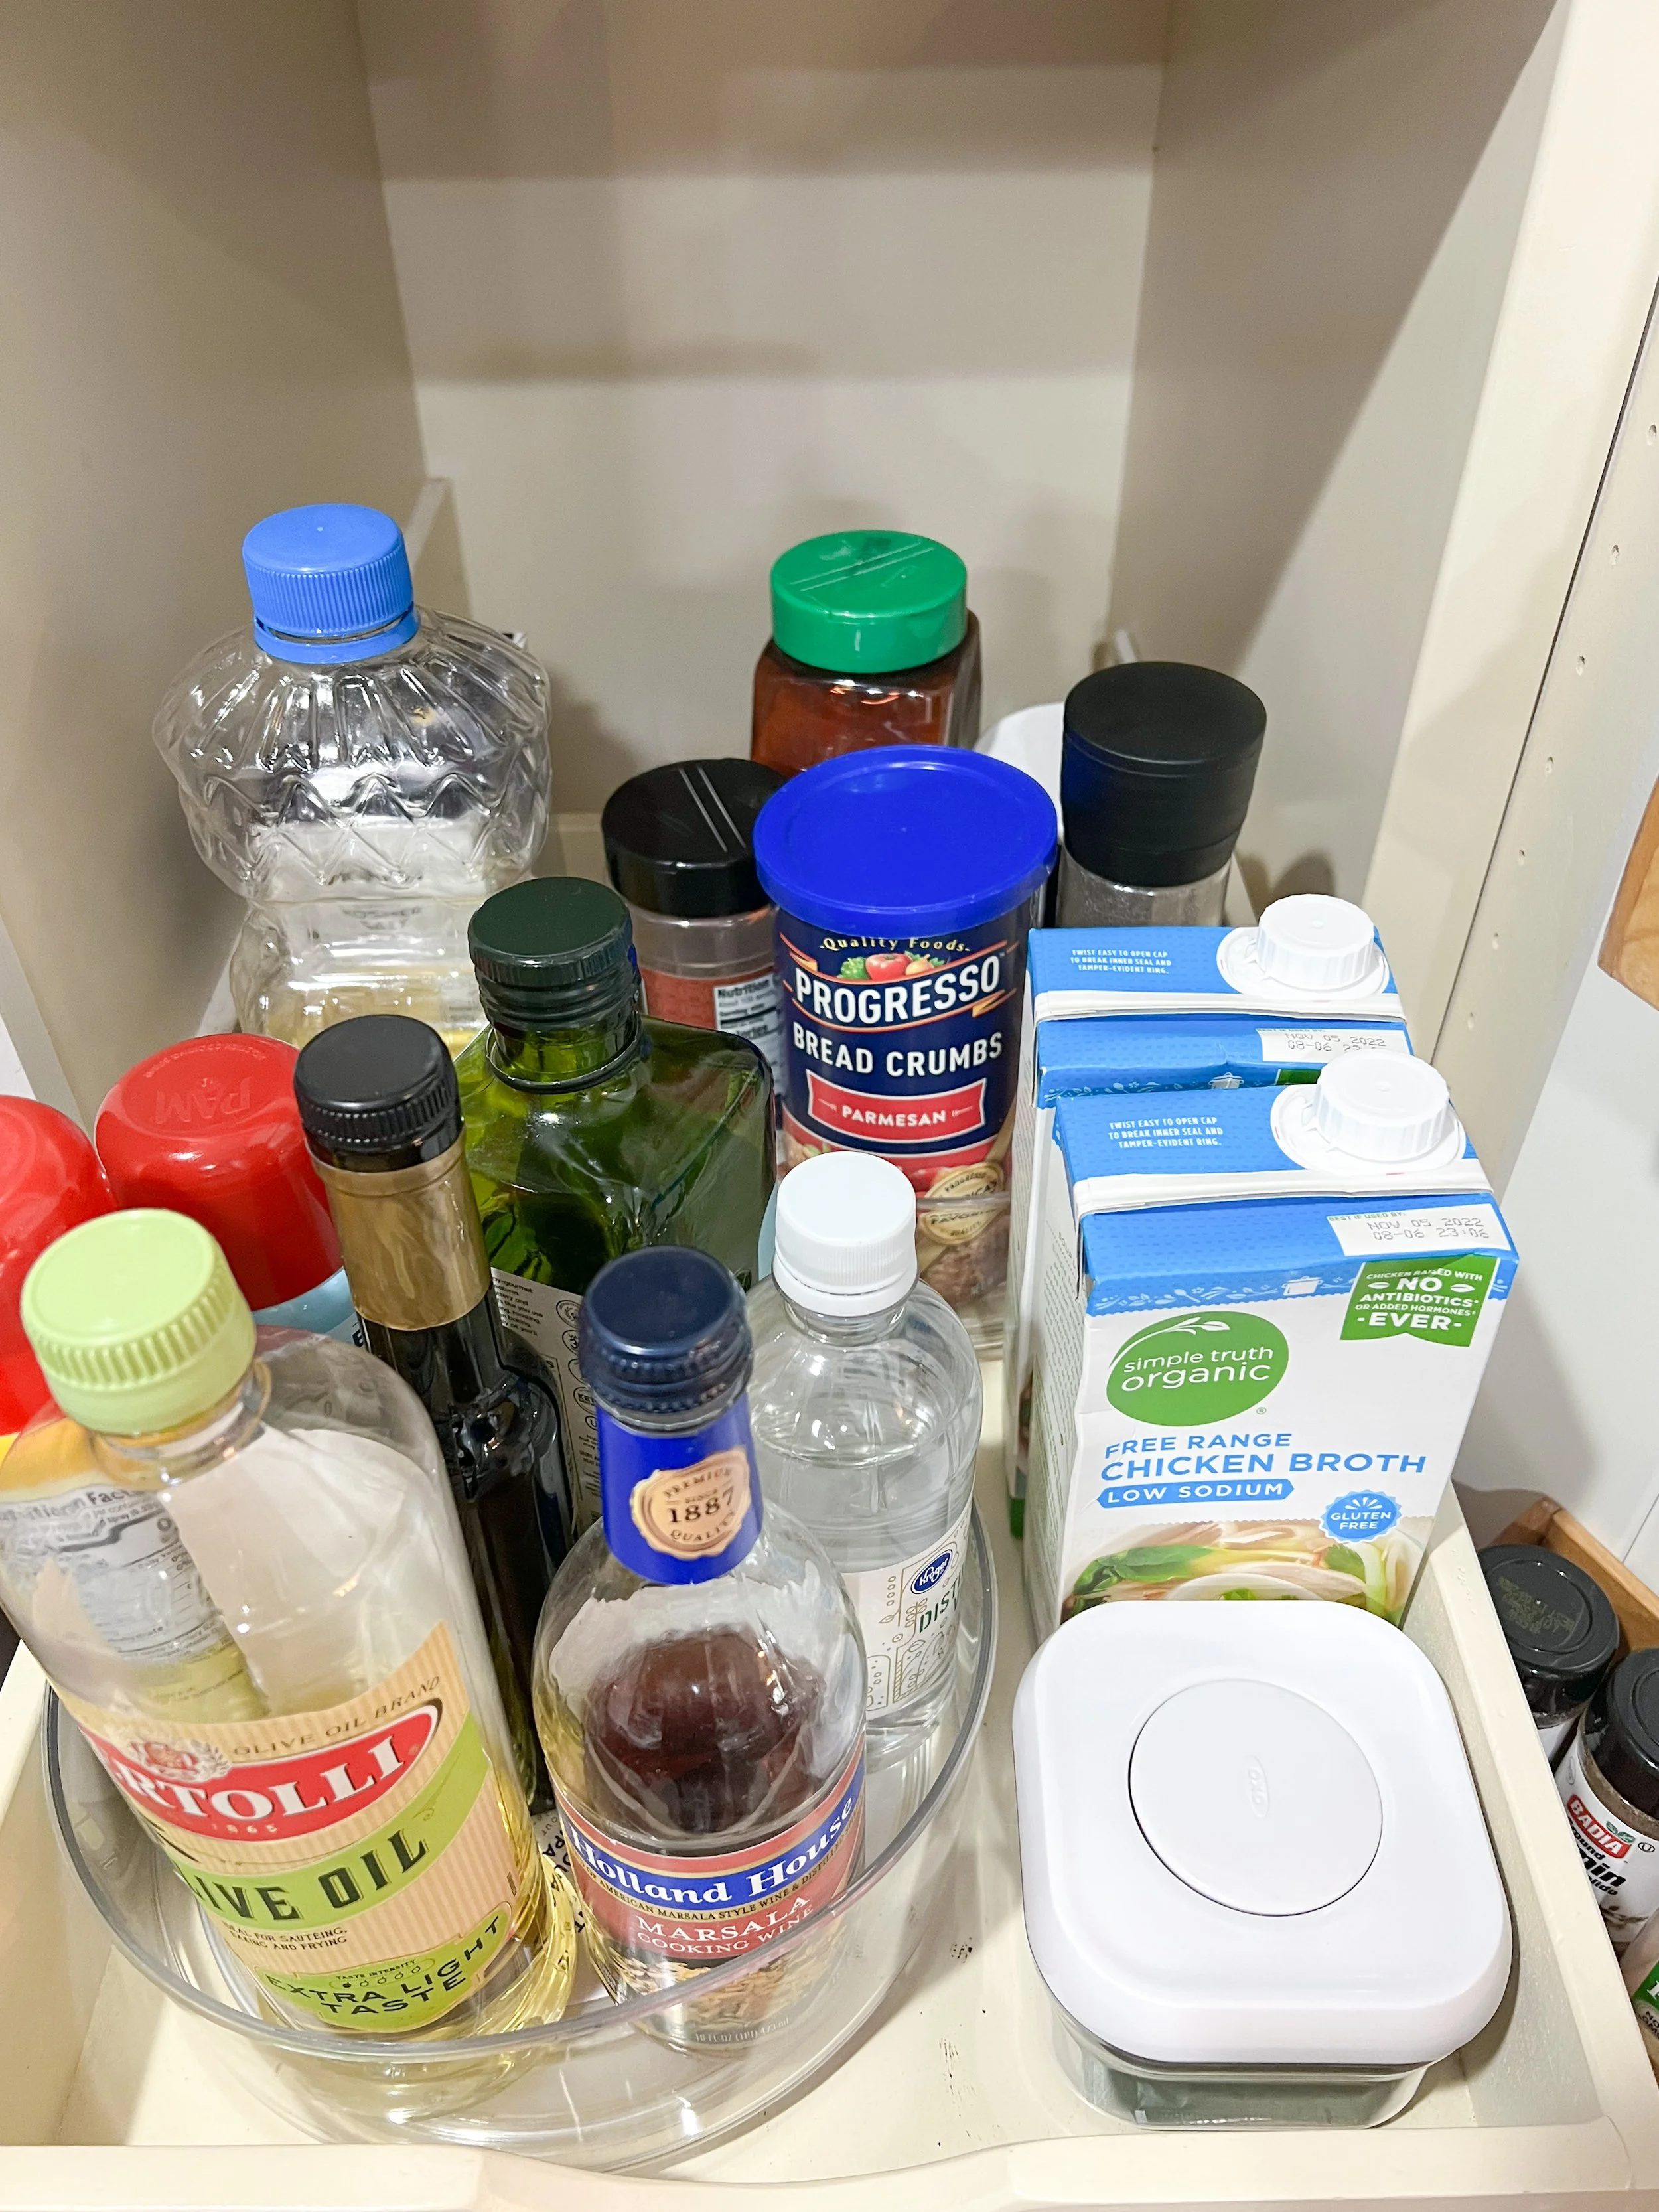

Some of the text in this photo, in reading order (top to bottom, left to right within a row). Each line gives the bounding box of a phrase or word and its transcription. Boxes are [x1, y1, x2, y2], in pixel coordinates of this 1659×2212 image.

[822, 936, 966, 952] Quality Foods
[1078, 964, 1145, 973] TAMPER-EVIDENT
[796, 955, 1000, 1025] PROGRESSO
[792, 1021, 1003, 1077] BREAD CRUMBS
[1287, 1040, 1332, 1051] 08-06
[1350, 1036, 1386, 1047] 2022
[841, 1104, 946, 1127] PARMESAN
[1109, 1116, 1217, 1130] TWIST EASY TO OPEN CAP
[1118, 1138, 1222, 1149] TAMPER-EVIDENT RING.
[1121, 1130, 1151, 1138] BREAK
[1153, 1128, 1180, 1137] INNER
[1183, 1128, 1202, 1136] SEAL
[1205, 1127, 1224, 1136] AND
[1366, 1218, 1485, 1230] NOV 05 2022
[1373, 1227, 1490, 1240] 08-06 23:06
[1366, 1270, 1412, 1280] CHICKEN
[1455, 1270, 1483, 1282] WITH
[1396, 1277, 1443, 1291] NO
[1123, 1347, 1273, 1372] simple truth
[1121, 1361, 1271, 1392] organic
[1105, 1433, 1292, 1459] FREE RANGE
[1101, 1453, 1427, 1481] CHICKEN BROTH
[668, 1485, 735, 1523] 1887
[1107, 1483, 1283, 1503] LOW SODIUM
[670, 1510, 736, 1541] QUALITY
[1331, 1512, 1392, 1520] GLUTEN
[1339, 1521, 1378, 1530] FREE
[919, 1557, 949, 1587] Kroger
[234, 1676, 440, 1755] OLIVE OIL BRAND
[112, 1735, 405, 1820] RTOLLI
[1570, 1799, 1623, 1854] BADIA
[569, 1823, 732, 1904] Holland
[746, 1797, 853, 1897] House
[318, 1829, 430, 1909] OIL
[599, 1880, 654, 1913] AMERICAN
[658, 1908, 715, 1921] MARSALA
[719, 1904, 756, 1919] STYLE
[761, 1889, 789, 1908] WINE
[792, 1883, 800, 1892] &
[802, 1838, 844, 1883] DISTILLED
[636, 1897, 810, 1941] MARSALA
[637, 1904, 813, 1954] COOKING WINE
[255, 1933, 275, 1943] FOR
[273, 1941, 297, 1951] AND
[301, 1935, 348, 1951] FRYING
[265, 1974, 388, 2003] EXTRA
[401, 1915, 499, 1994] LIGHT
[368, 1959, 417, 1977] INTENSITY
[321, 1970, 467, 2015] TASTE
